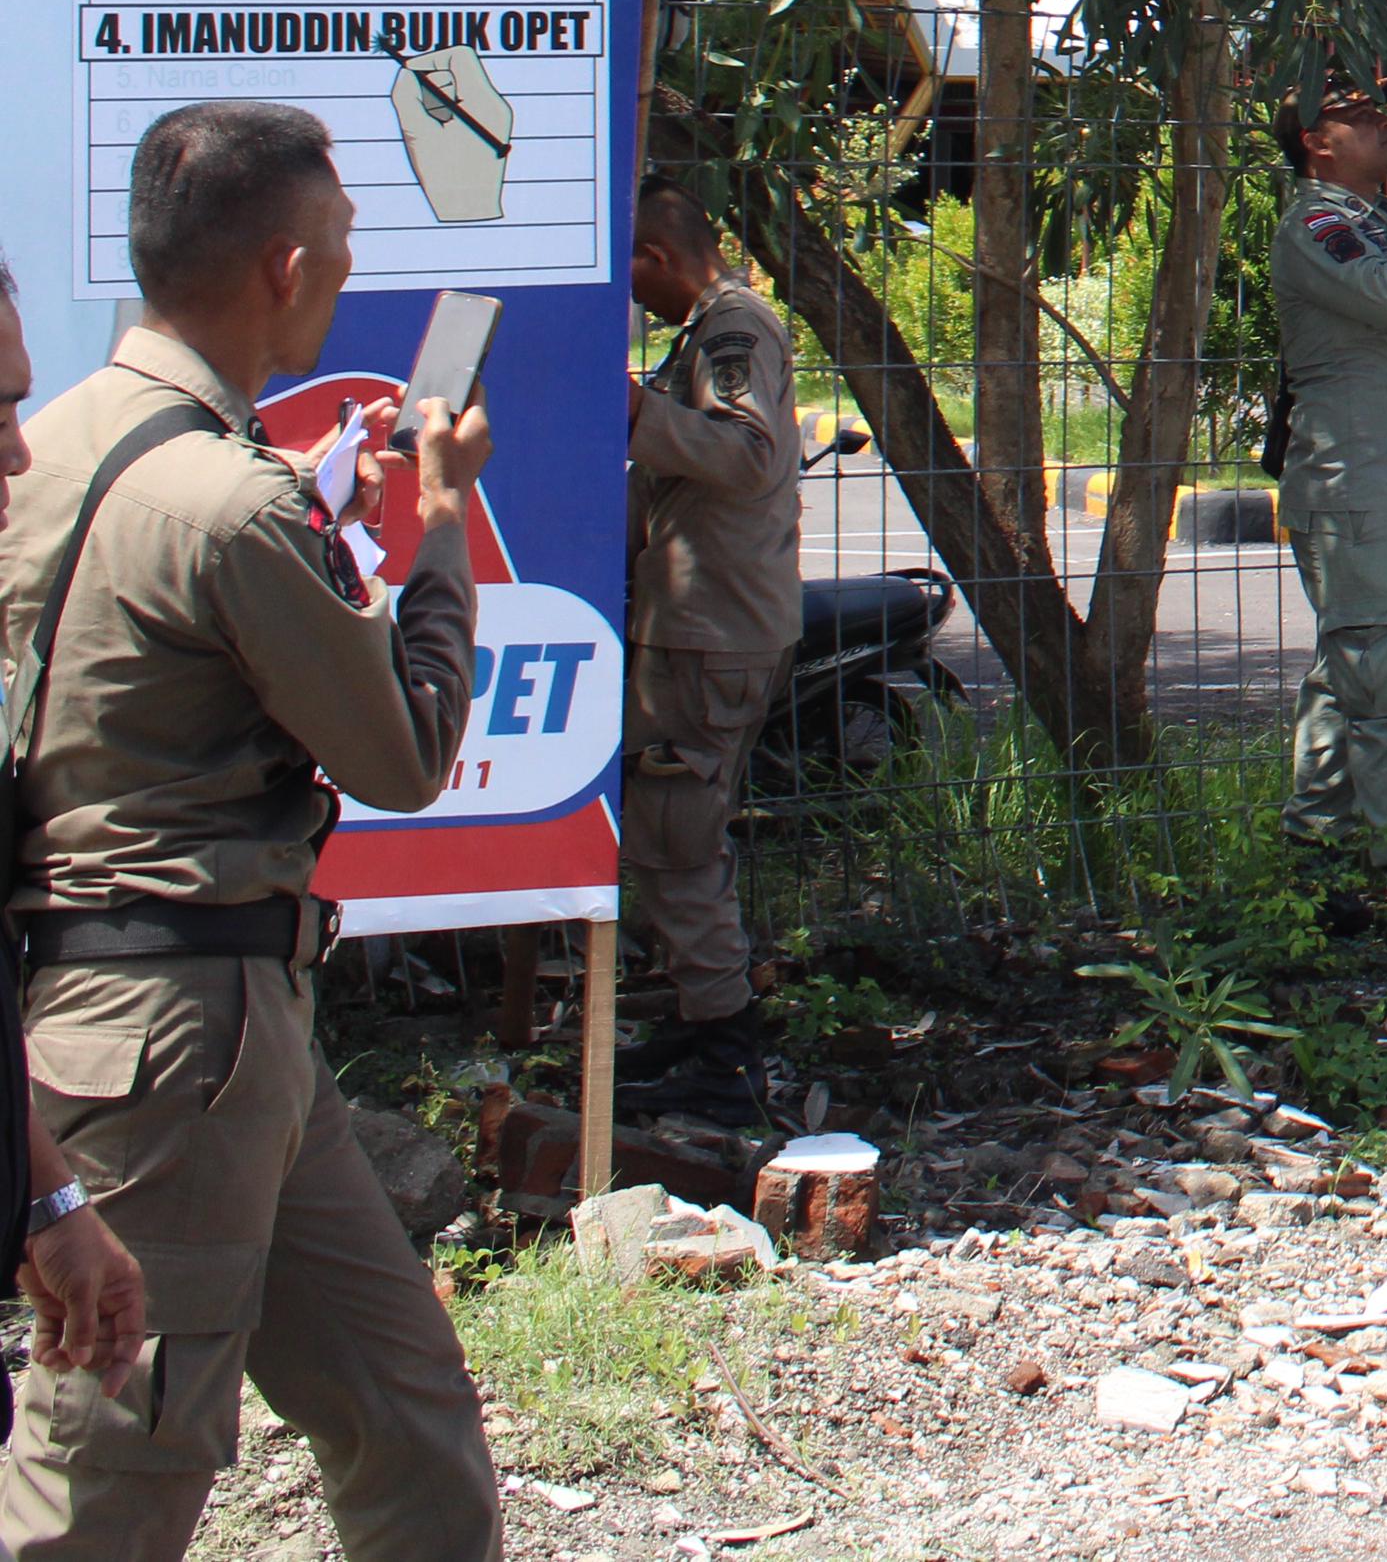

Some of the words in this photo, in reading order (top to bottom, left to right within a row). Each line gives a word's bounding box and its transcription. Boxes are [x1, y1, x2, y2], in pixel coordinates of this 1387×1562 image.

[94, 12, 132, 54] 4.
[142, 11, 371, 54] IMANUDDIN
[500, 10, 591, 52] OPET
